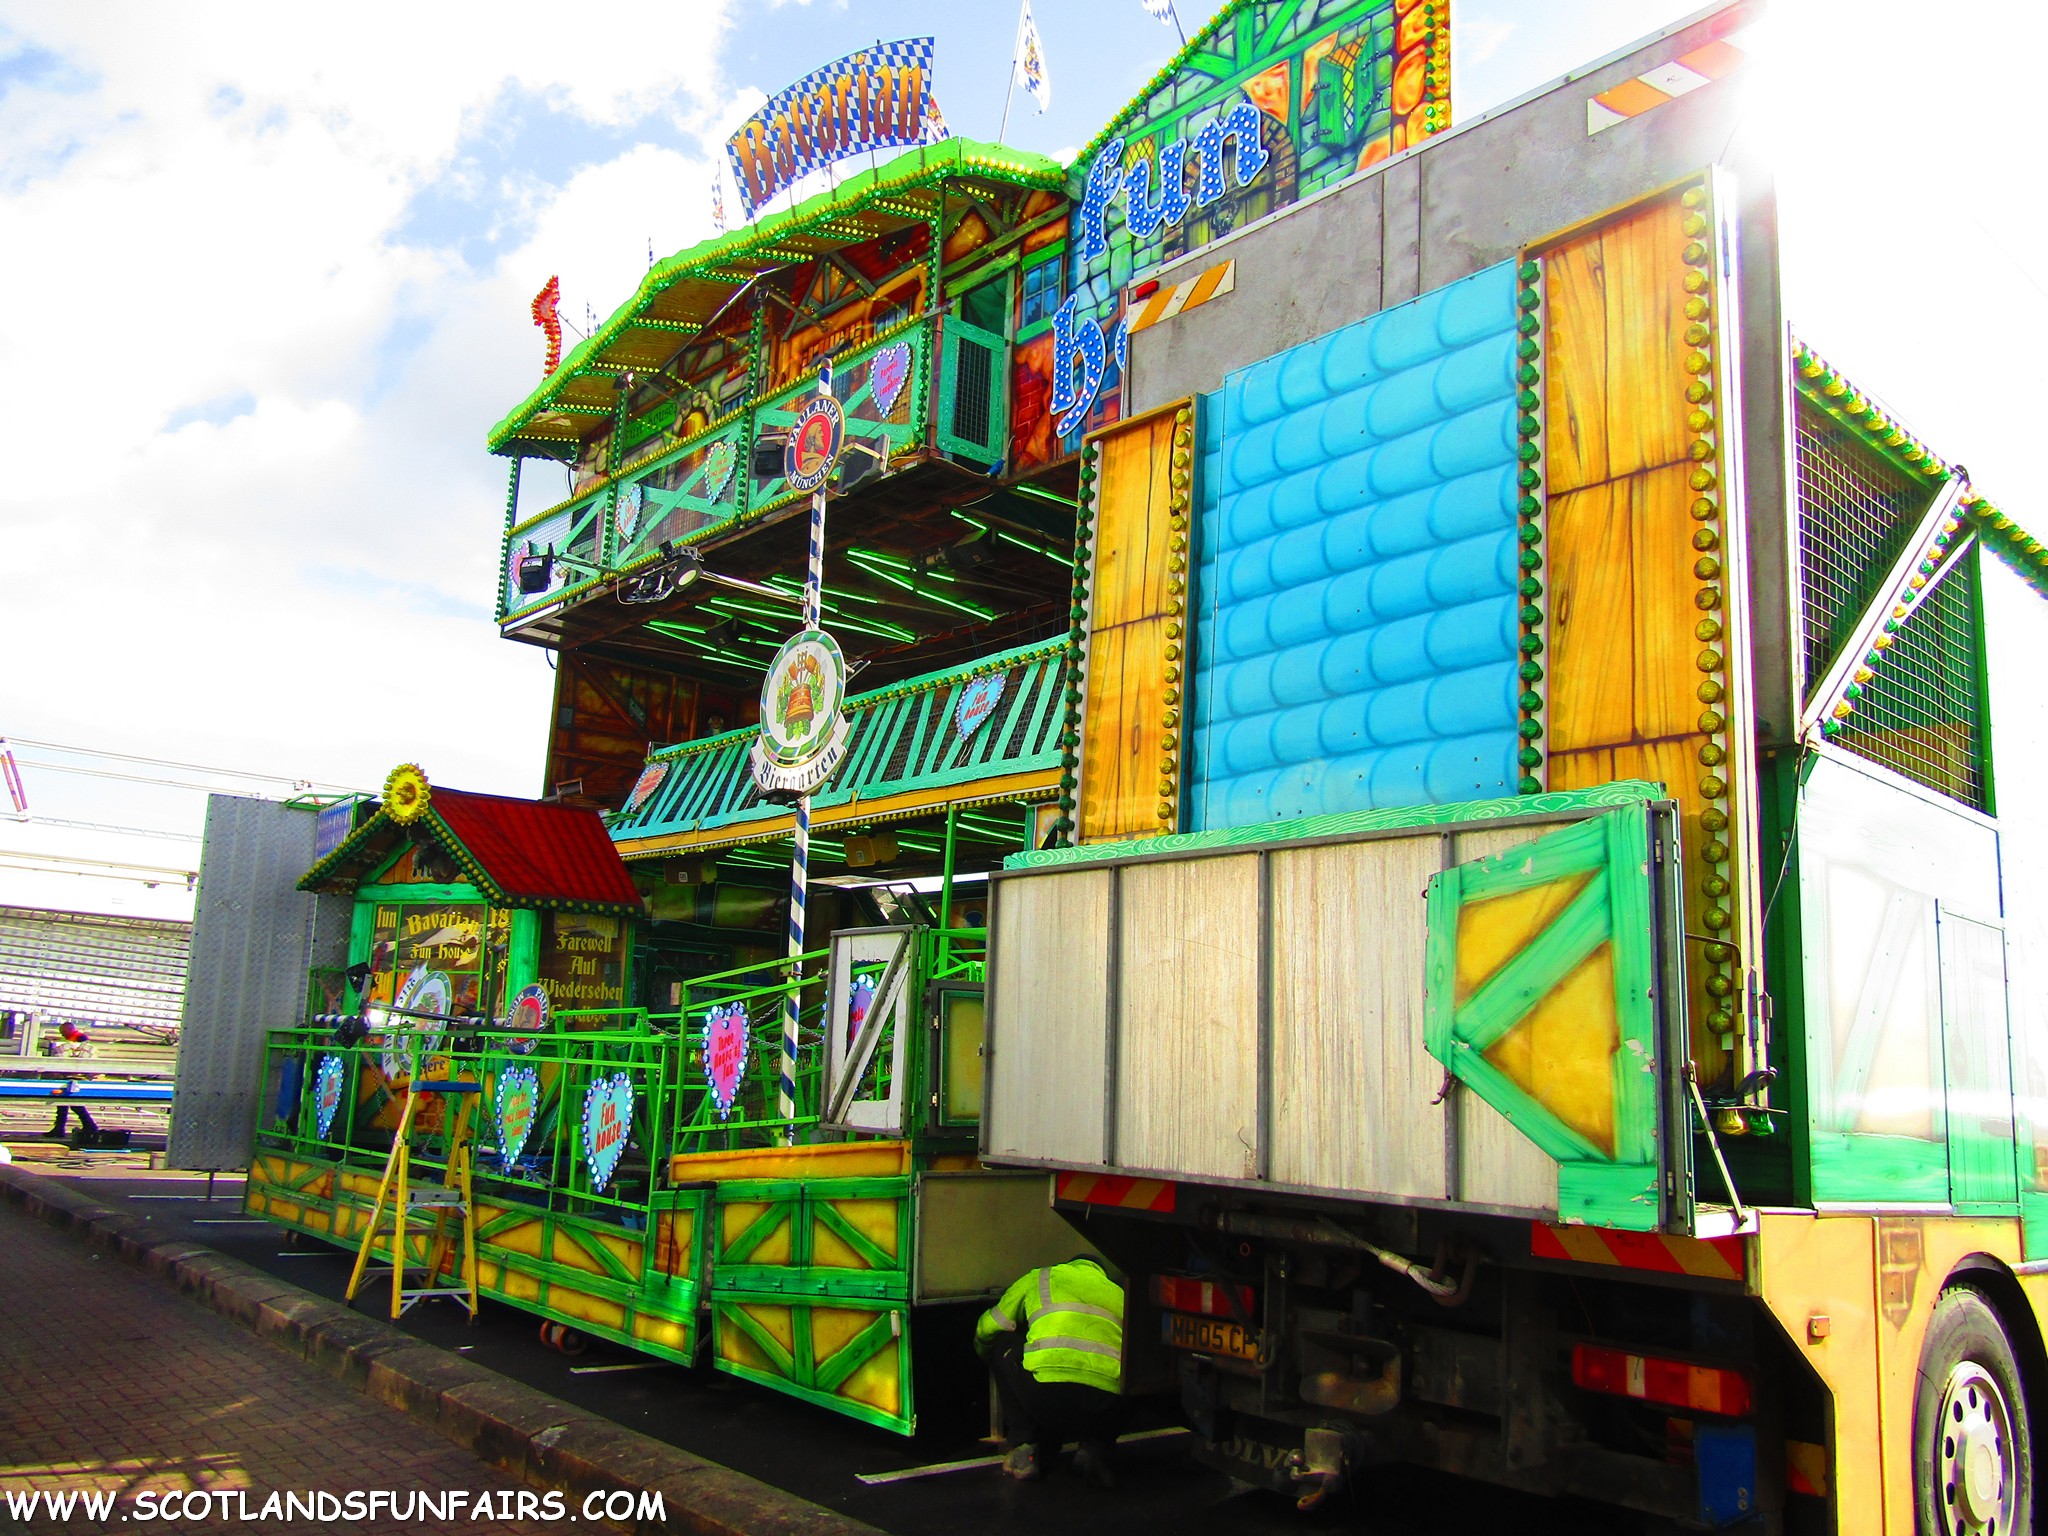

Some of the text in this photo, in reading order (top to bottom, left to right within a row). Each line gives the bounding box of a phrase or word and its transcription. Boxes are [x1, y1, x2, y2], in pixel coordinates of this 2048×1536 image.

[731, 52, 922, 207] Bavarian
[1080, 102, 1269, 265] fun
[788, 399, 840, 448] PAULANER
[789, 454, 834, 490] MÜNCHEN
[759, 747, 839, 791] Biergarten
[406, 912, 480, 936] Bavarian
[556, 931, 612, 953] Farewell
[568, 955, 598, 976] Auf
[537, 977, 624, 1001] Wiedersehen
[595, 1120, 622, 1154] house
